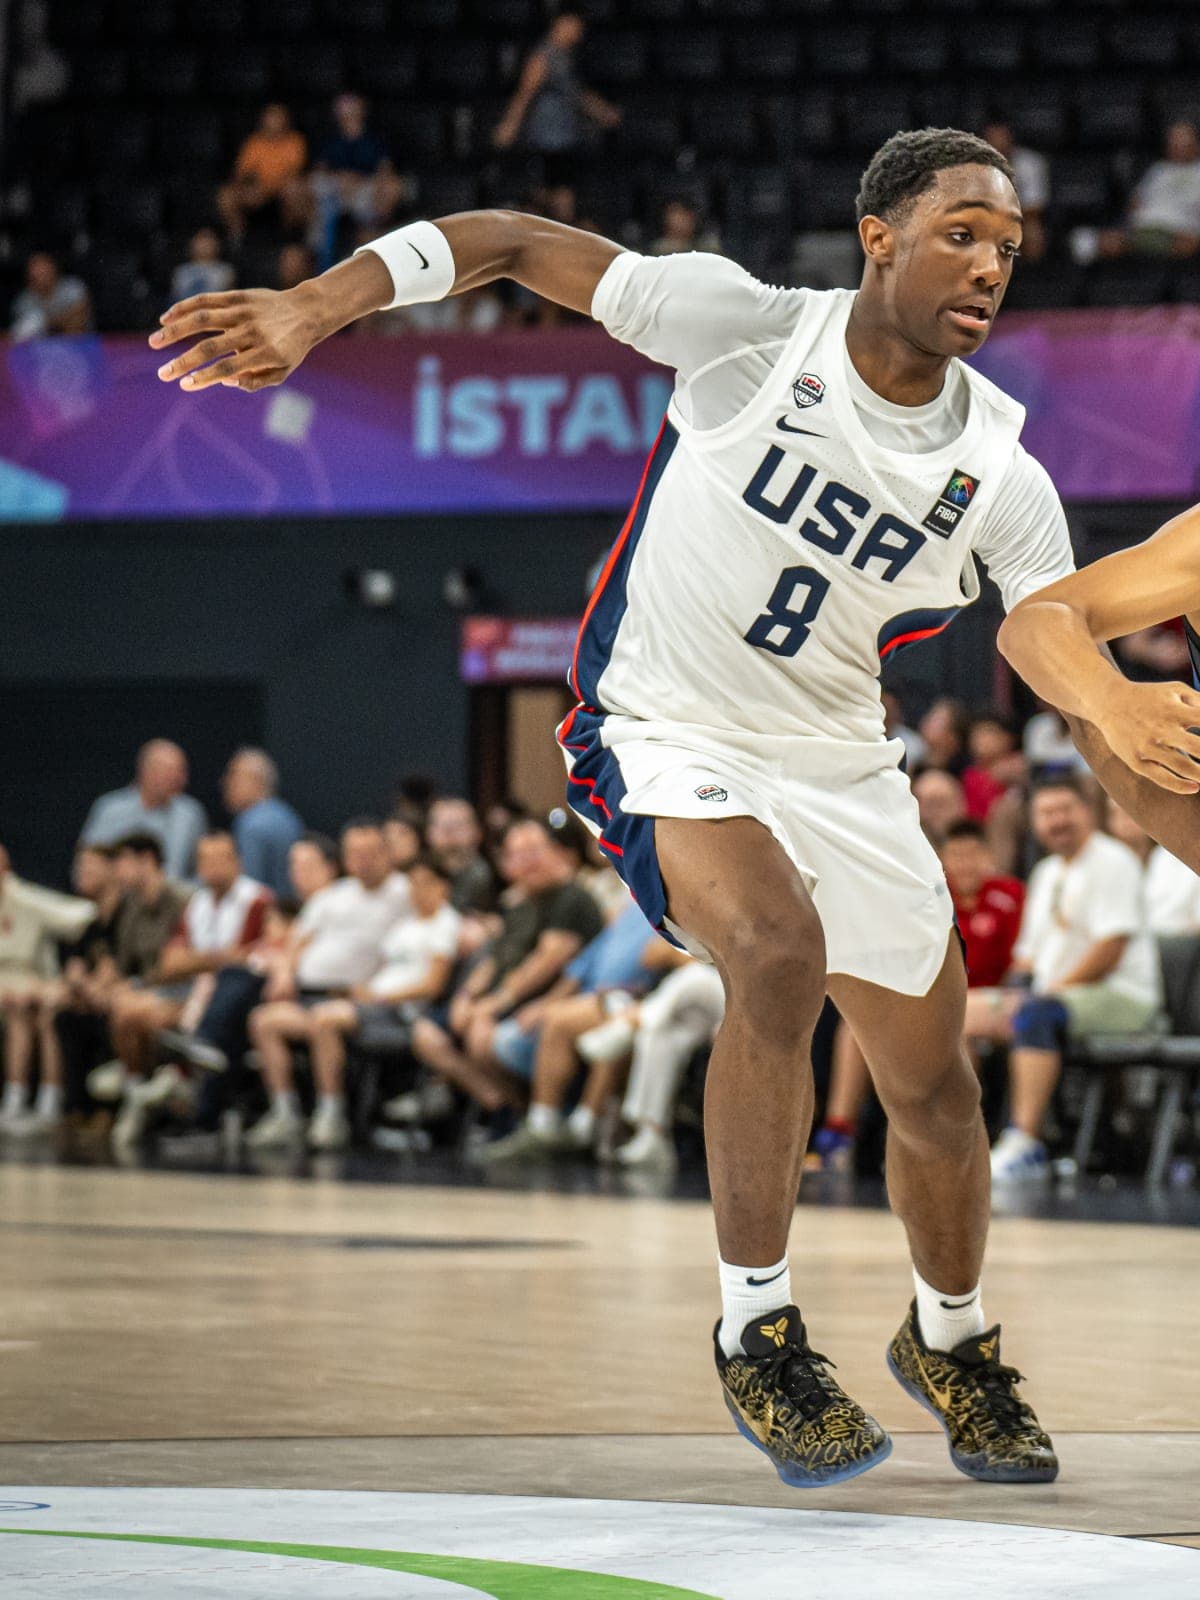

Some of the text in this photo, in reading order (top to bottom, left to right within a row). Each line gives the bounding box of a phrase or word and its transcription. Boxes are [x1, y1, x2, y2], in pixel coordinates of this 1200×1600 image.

[742, 443, 928, 583] USA
[935, 505, 957, 524] FIBA
[743, 564, 831, 657] 8
